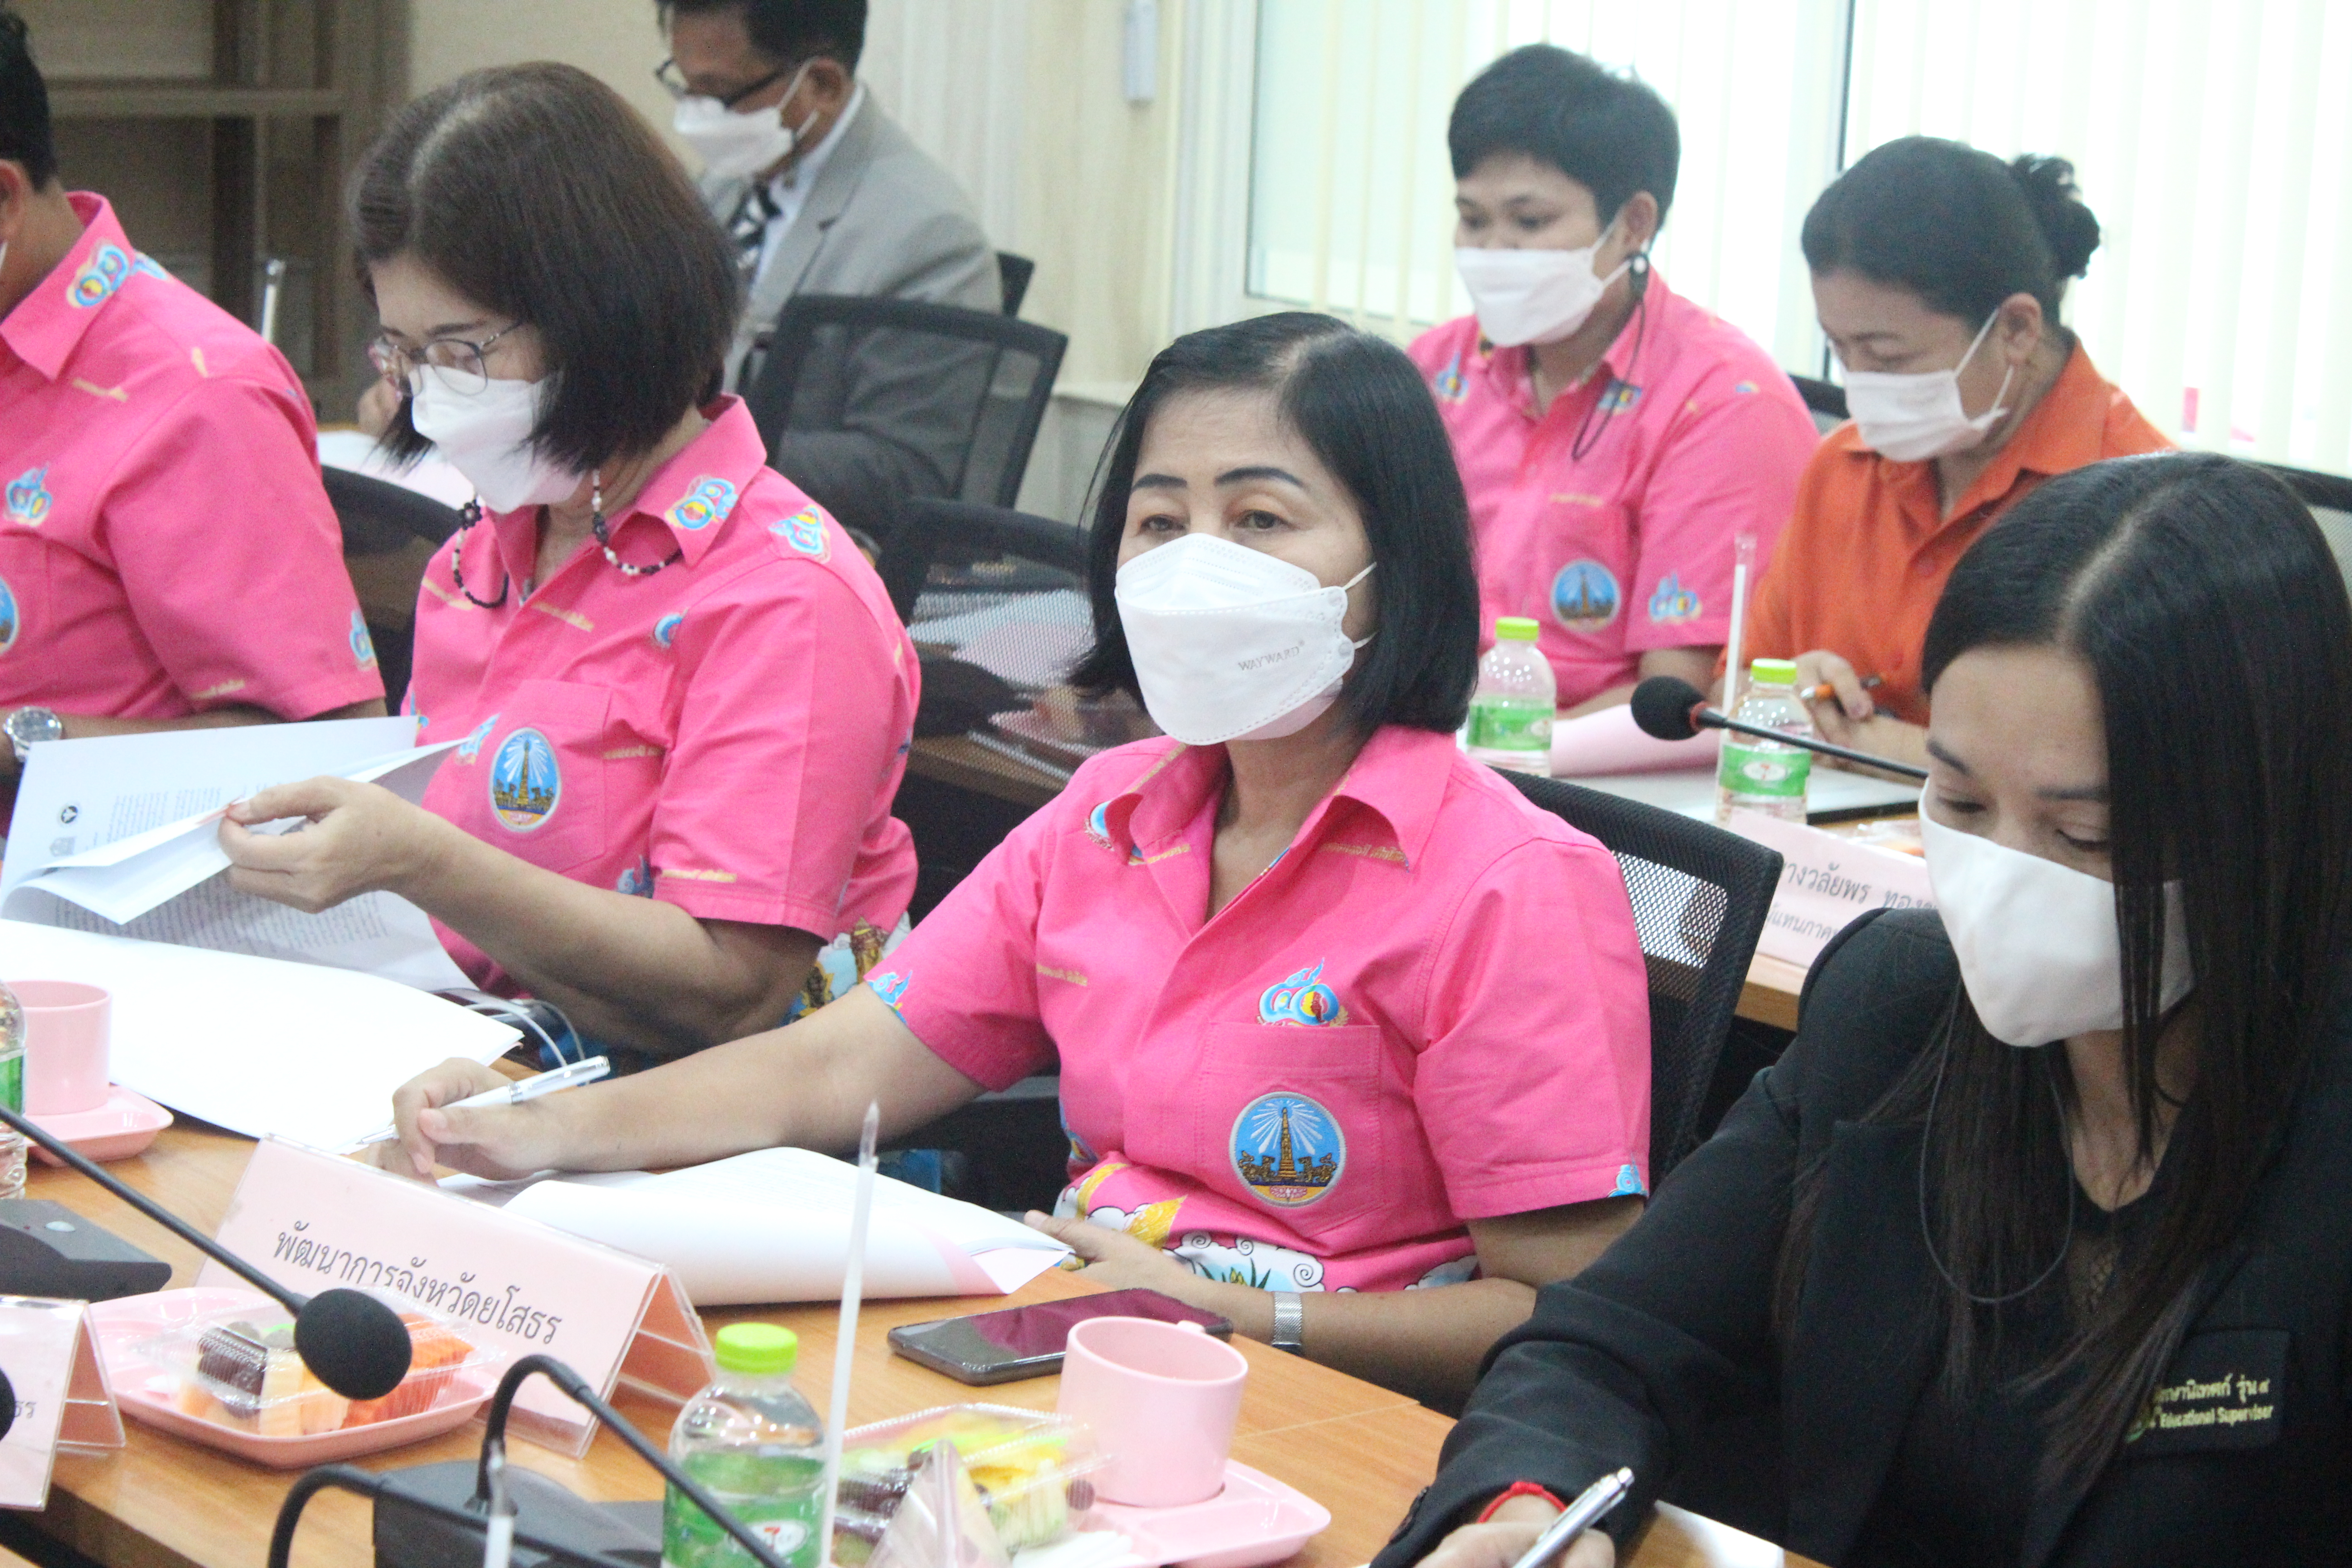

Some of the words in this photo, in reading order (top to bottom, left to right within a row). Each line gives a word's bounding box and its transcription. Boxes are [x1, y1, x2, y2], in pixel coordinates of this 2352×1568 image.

[1237, 646, 1300, 671] WAYWARD
[1784, 862, 1872, 904] างวลัยพร
[273, 1220, 562, 1344] พัฒนาการจังหวัดยโสธร
